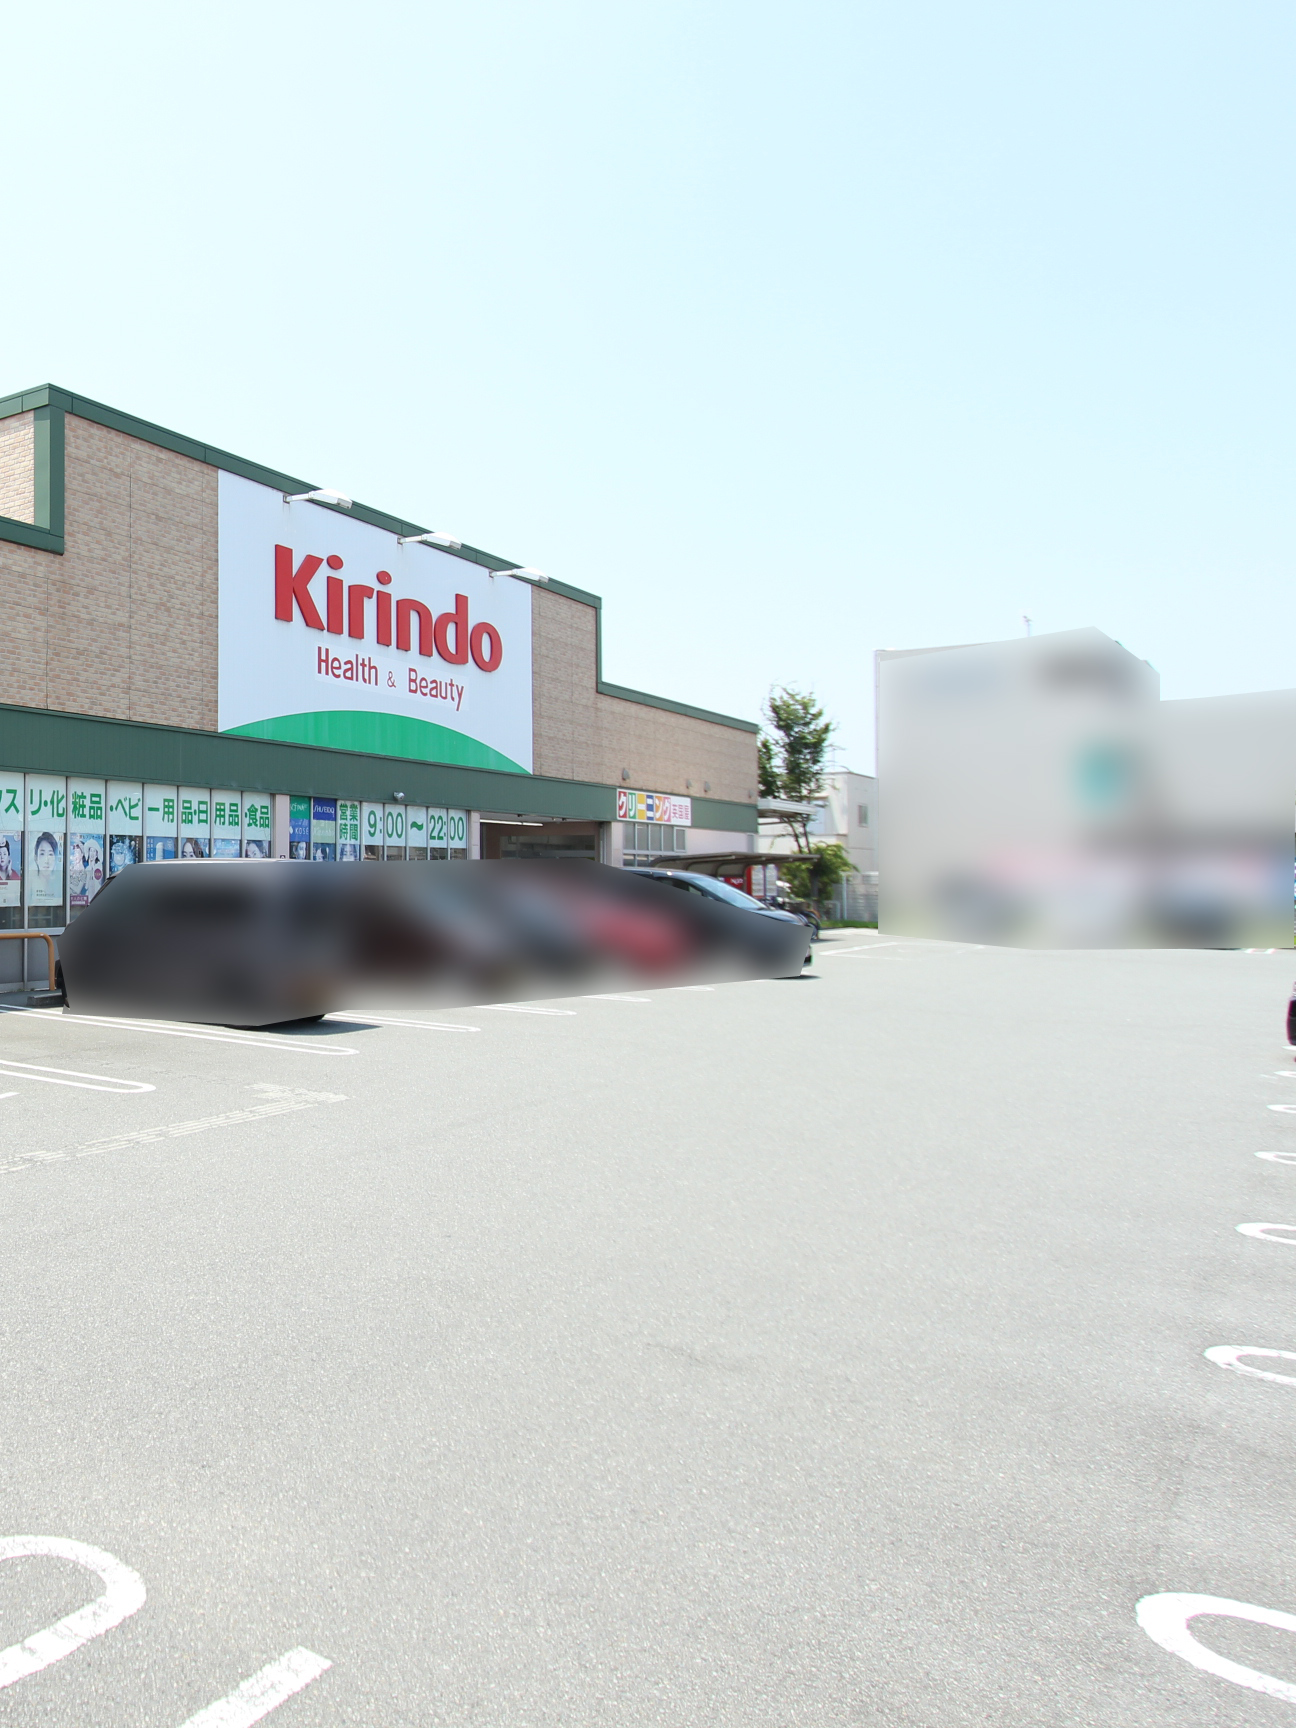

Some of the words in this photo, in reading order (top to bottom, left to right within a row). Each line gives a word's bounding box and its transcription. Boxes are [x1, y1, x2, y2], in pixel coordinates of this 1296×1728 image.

[274, 543, 503, 673] Kirindo
[316, 645, 379, 687] Health
[386, 670, 397, 689] &
[407, 667, 465, 712] Beauty
[618, 791, 671, 821] クリーニング
